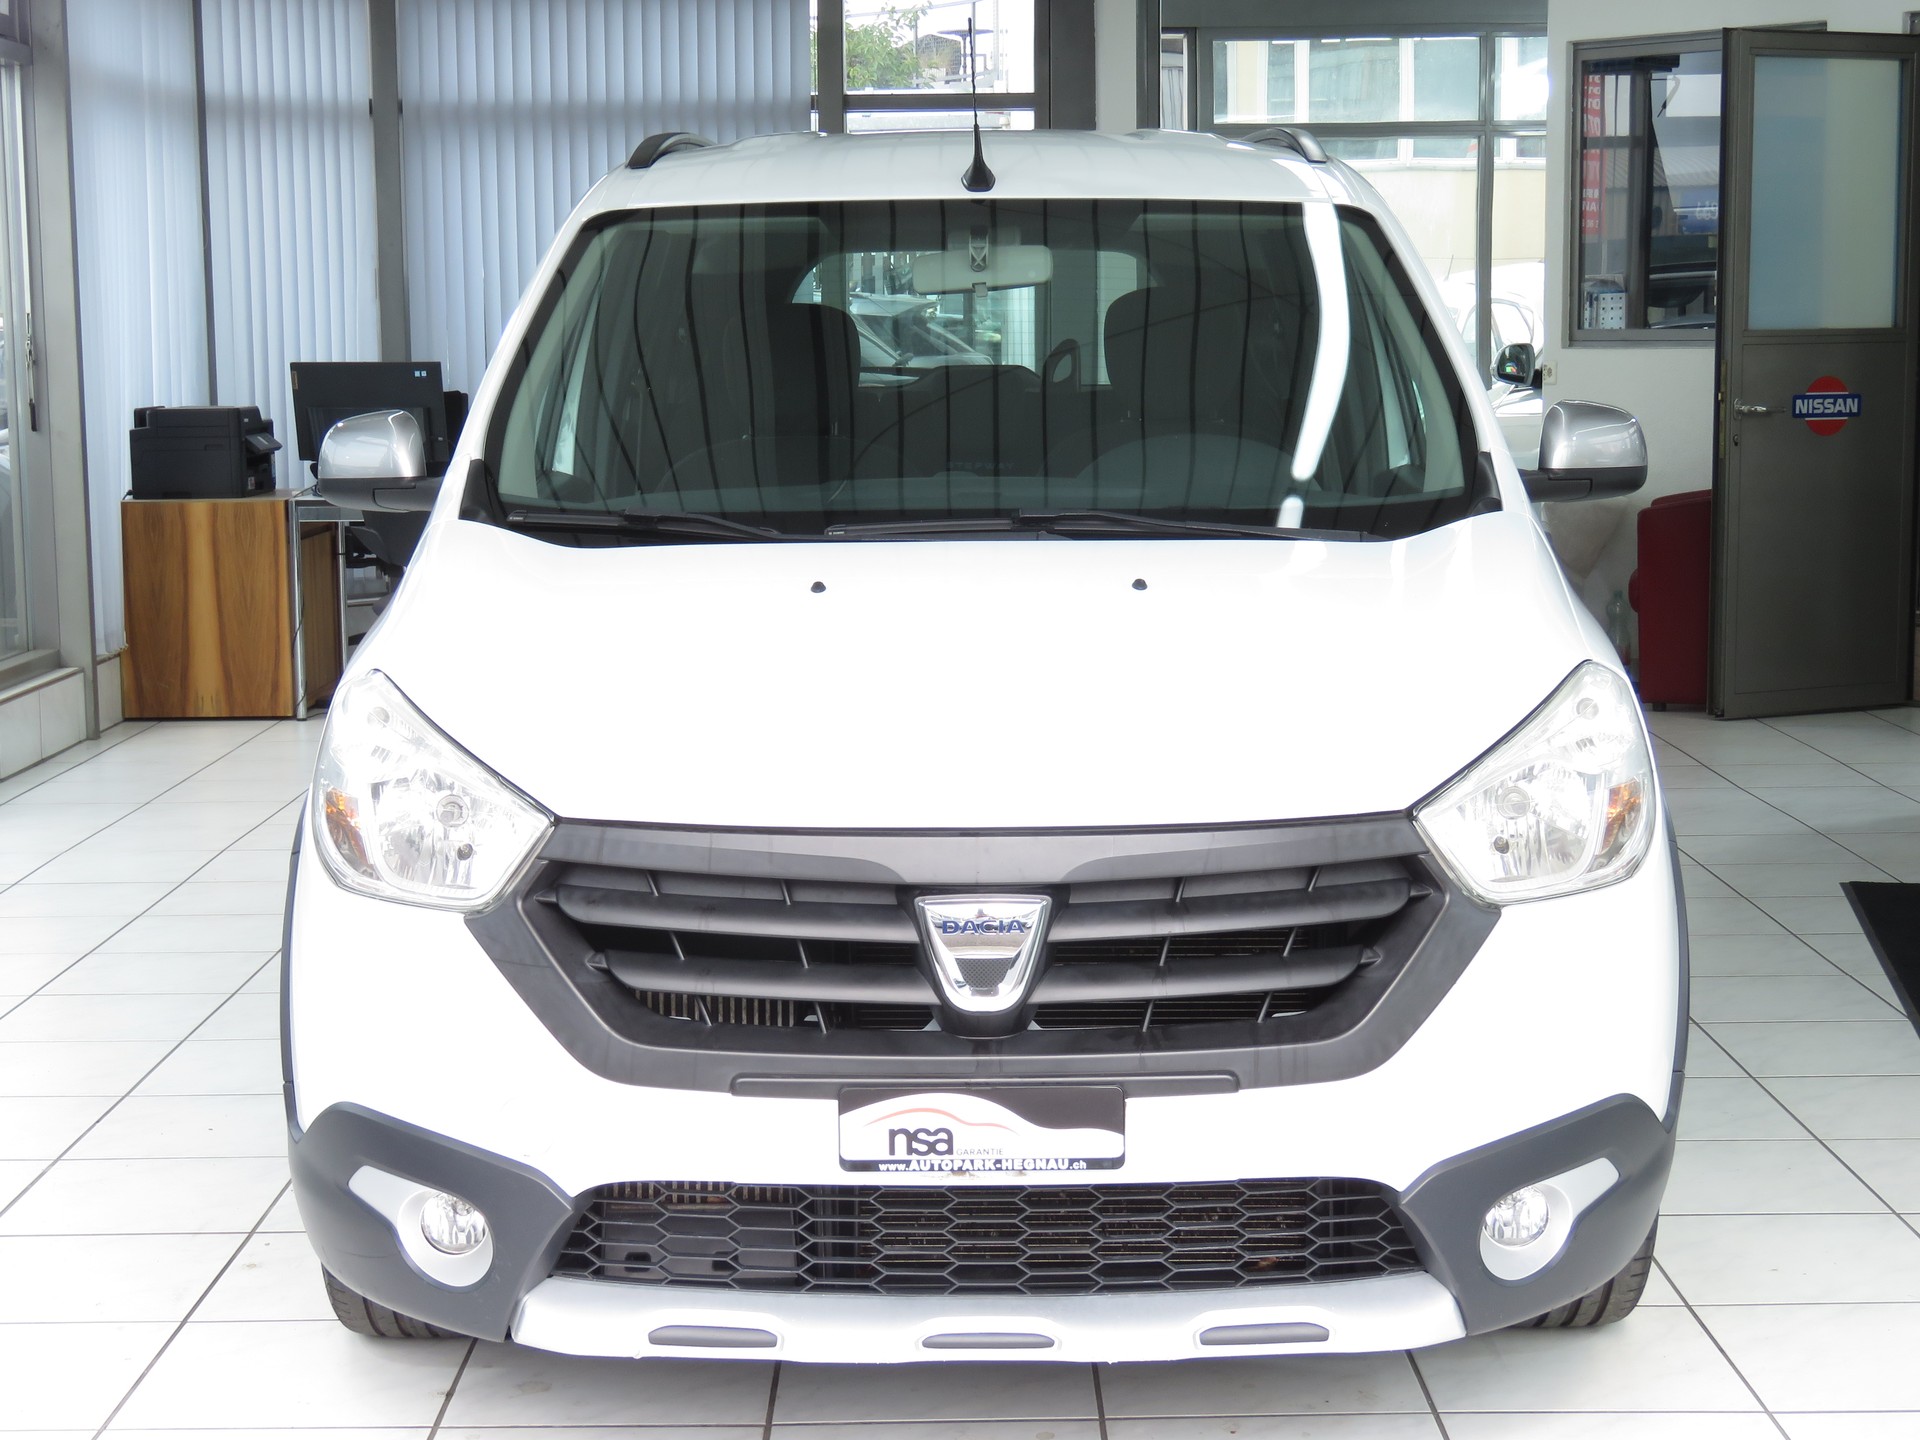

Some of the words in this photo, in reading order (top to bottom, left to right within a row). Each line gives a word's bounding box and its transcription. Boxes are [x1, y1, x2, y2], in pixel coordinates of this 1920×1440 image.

[1795, 398, 1859, 414] NISSAN
[942, 920, 1025, 935] DACIA
[888, 1127, 954, 1157] nsa
[956, 1148, 1004, 1156] GARANTIE
[878, 1158, 1087, 1171] www.AUTOPARK-HEGNAU.ch
